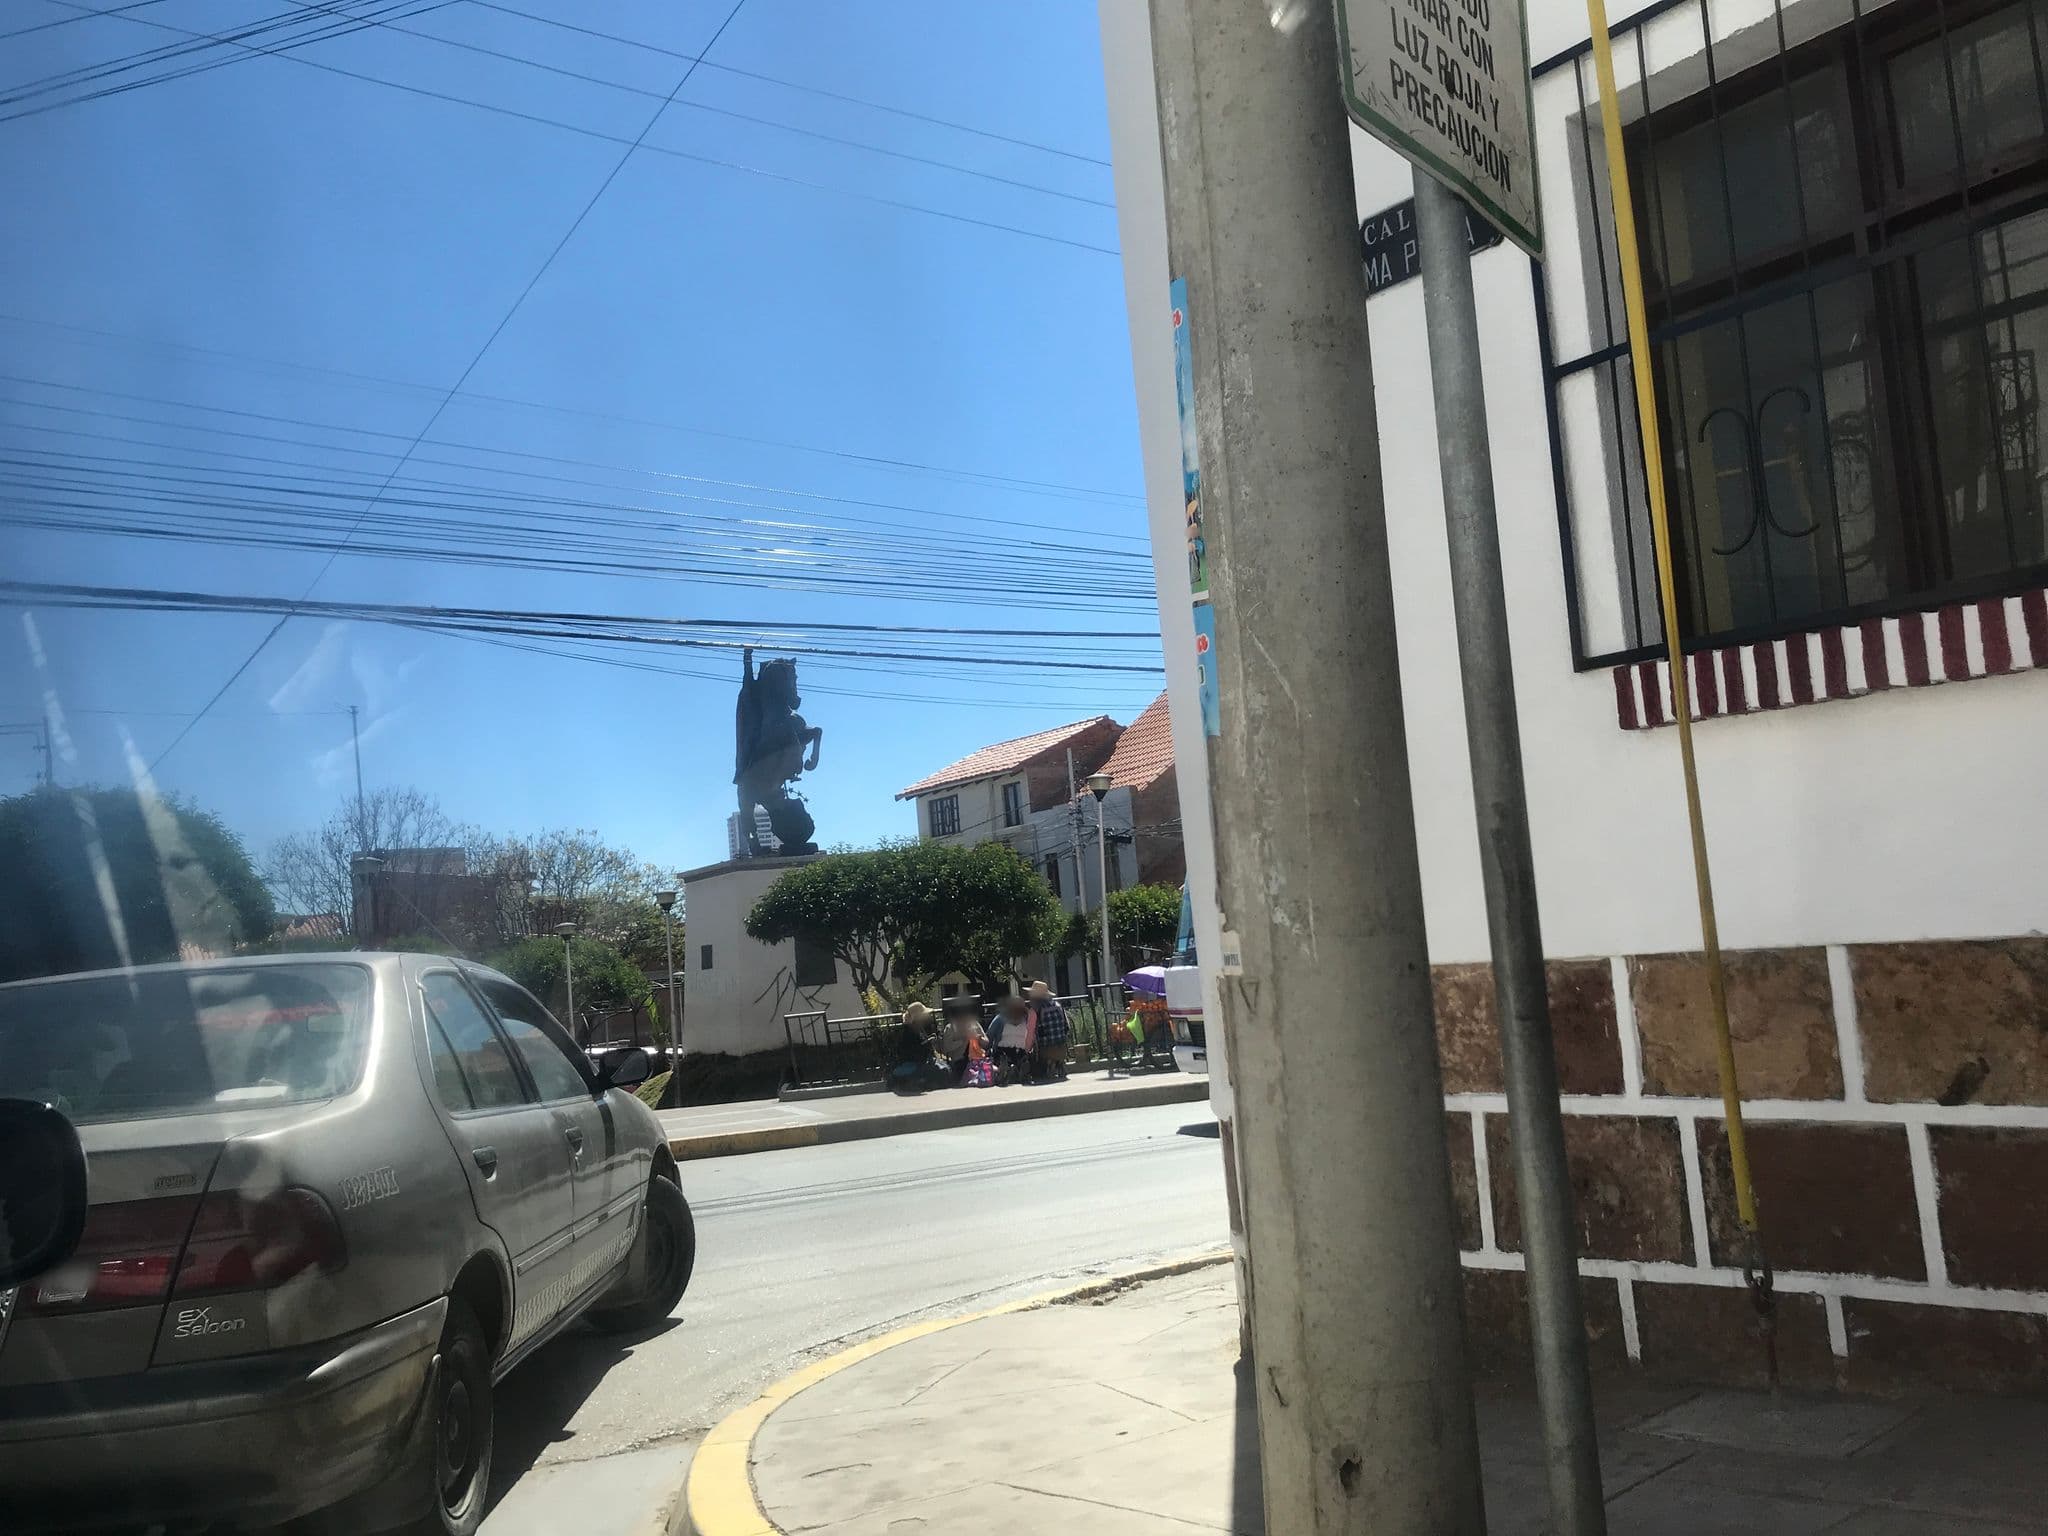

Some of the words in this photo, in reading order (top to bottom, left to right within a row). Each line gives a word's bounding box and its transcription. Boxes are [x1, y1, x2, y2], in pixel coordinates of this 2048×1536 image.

[1458, 16, 1495, 81] CON
[1391, 6, 1432, 75] LUZ
[1437, 45, 1486, 122] ROJA
[1490, 93, 1499, 132] Y
[1390, 58, 1511, 193] PRECAUCION
[1364, 209, 1411, 245] CAL
[1363, 252, 1393, 287] MA
[174, 1319, 246, 1338] Saloon
[178, 1306, 212, 1322] EX
